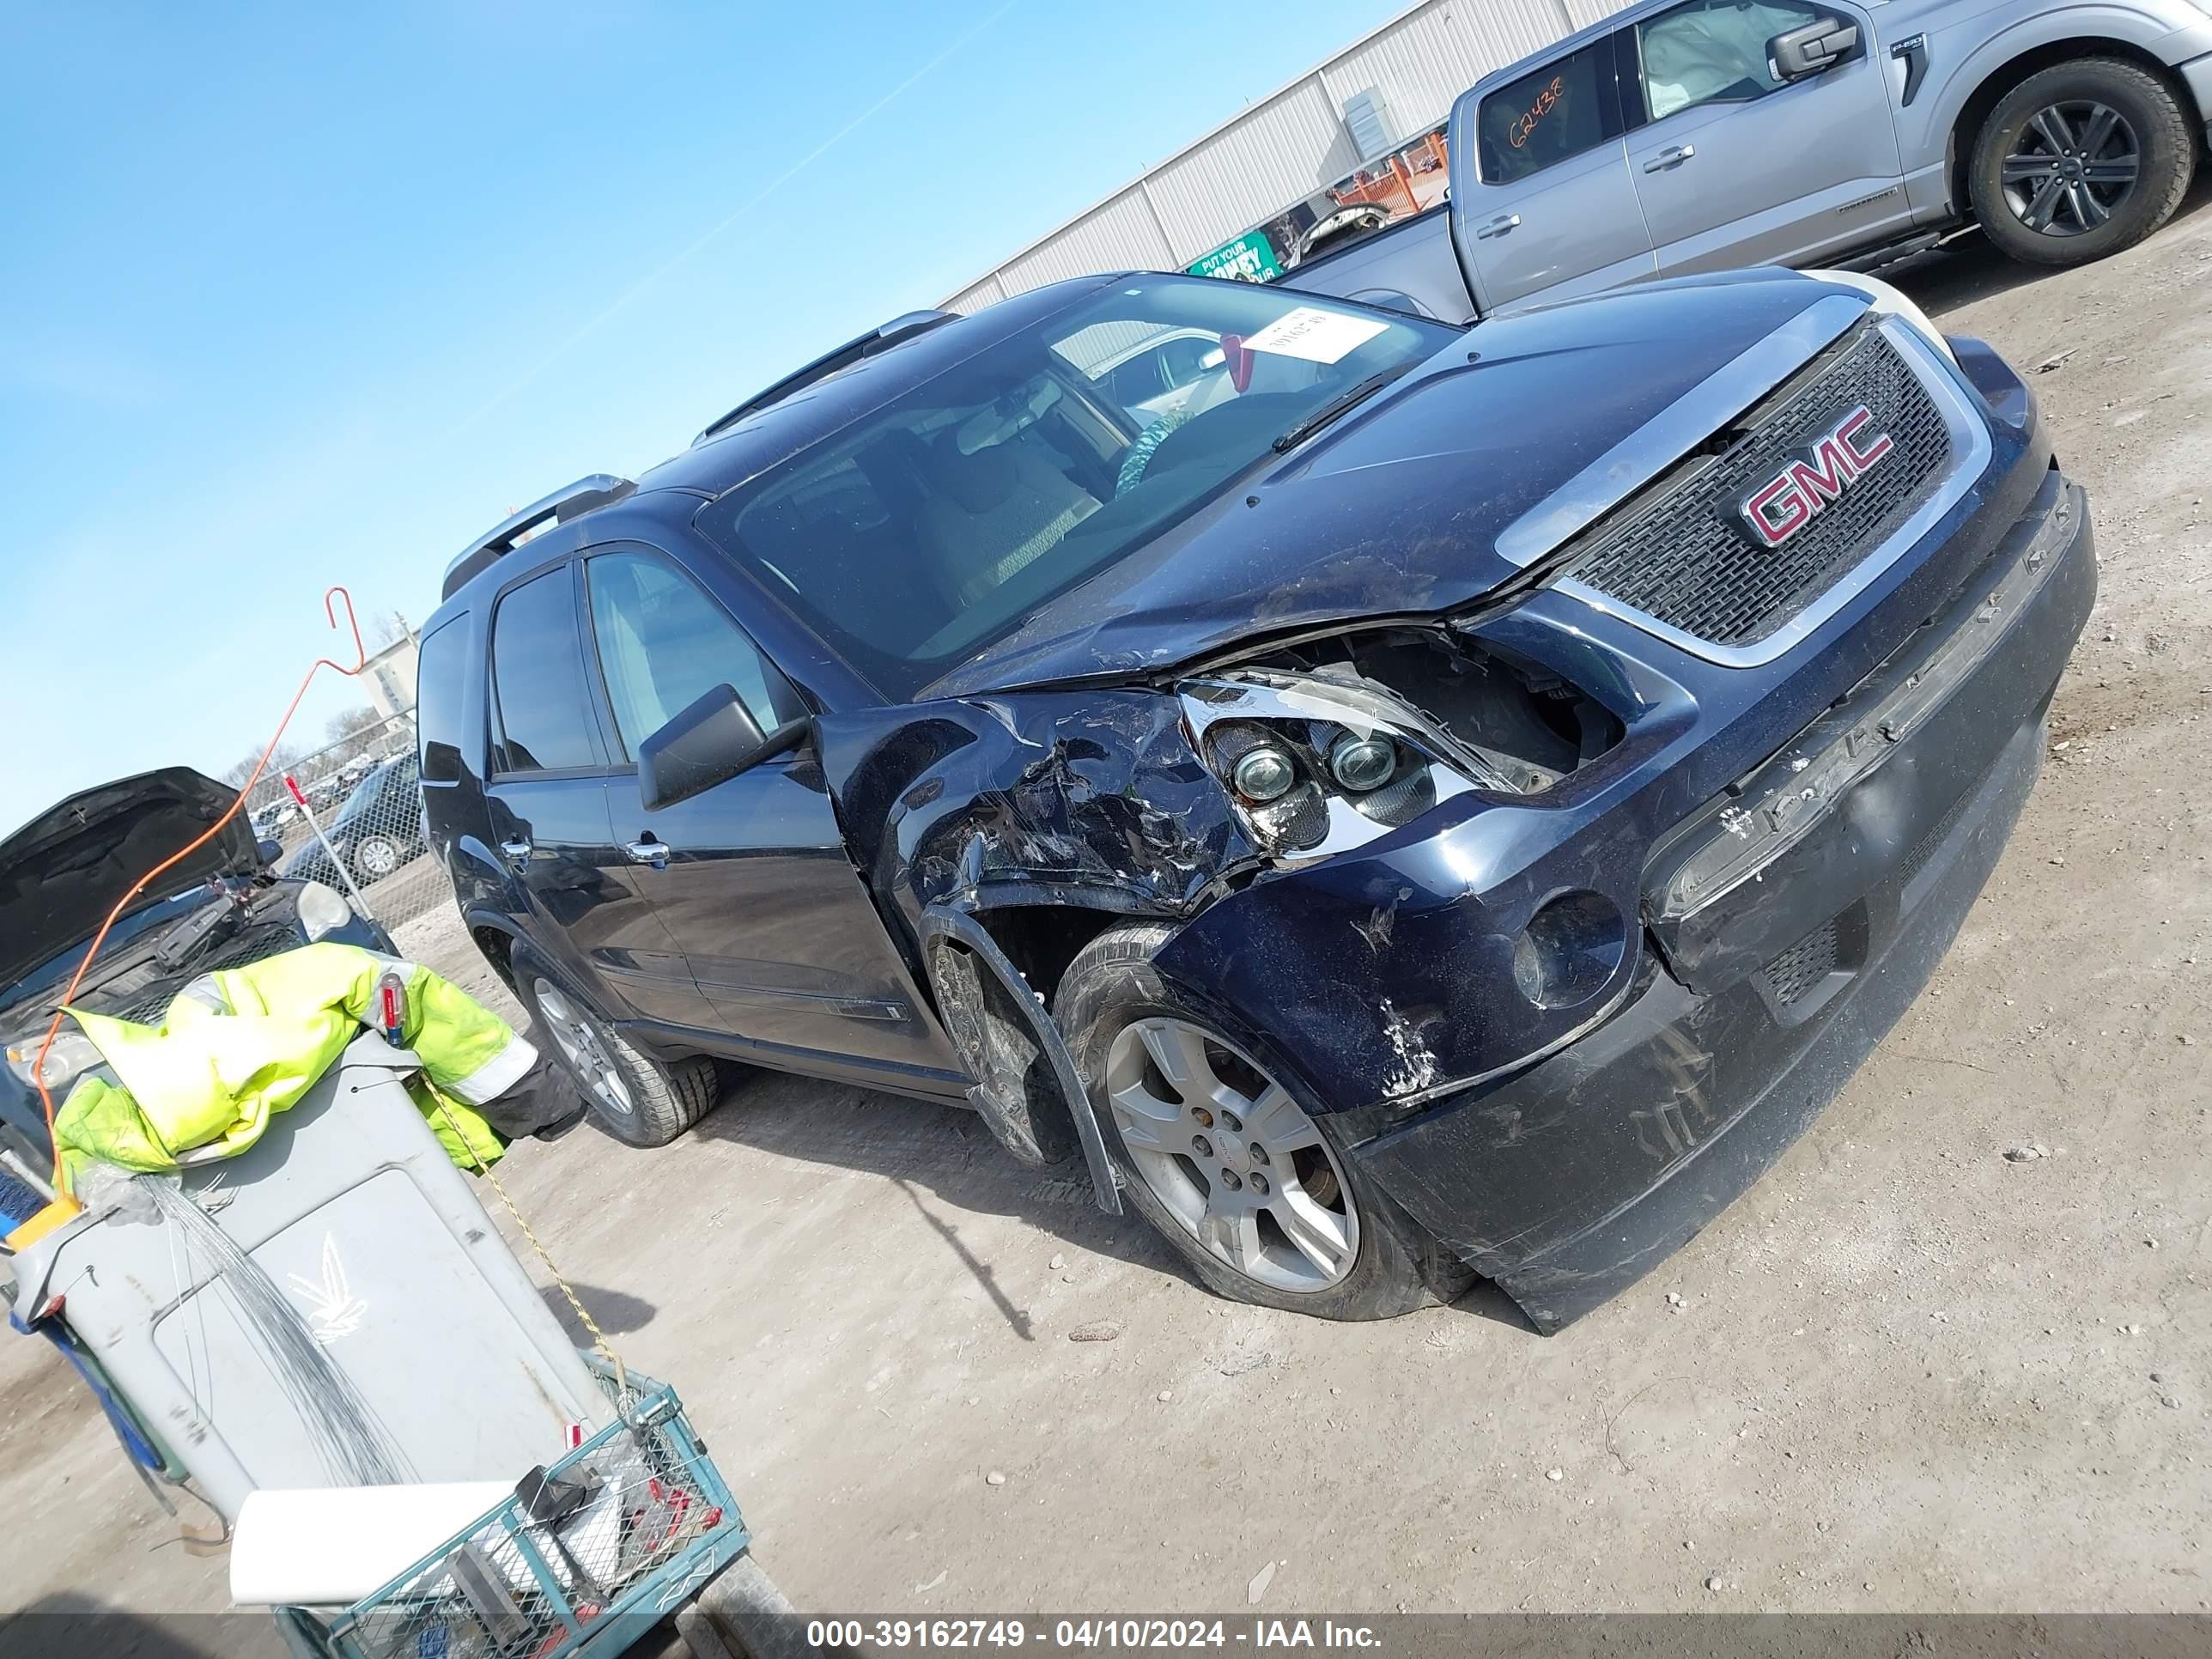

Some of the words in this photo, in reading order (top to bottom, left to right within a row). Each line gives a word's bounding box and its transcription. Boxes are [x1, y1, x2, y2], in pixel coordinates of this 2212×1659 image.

[1510, 76, 1564, 148] 62438
[1201, 255, 1220, 272] PUT
[1219, 240, 1247, 263] YOUR
[1739, 404, 1894, 548] GMC
[1218, 1136, 1237, 1169] GMC
